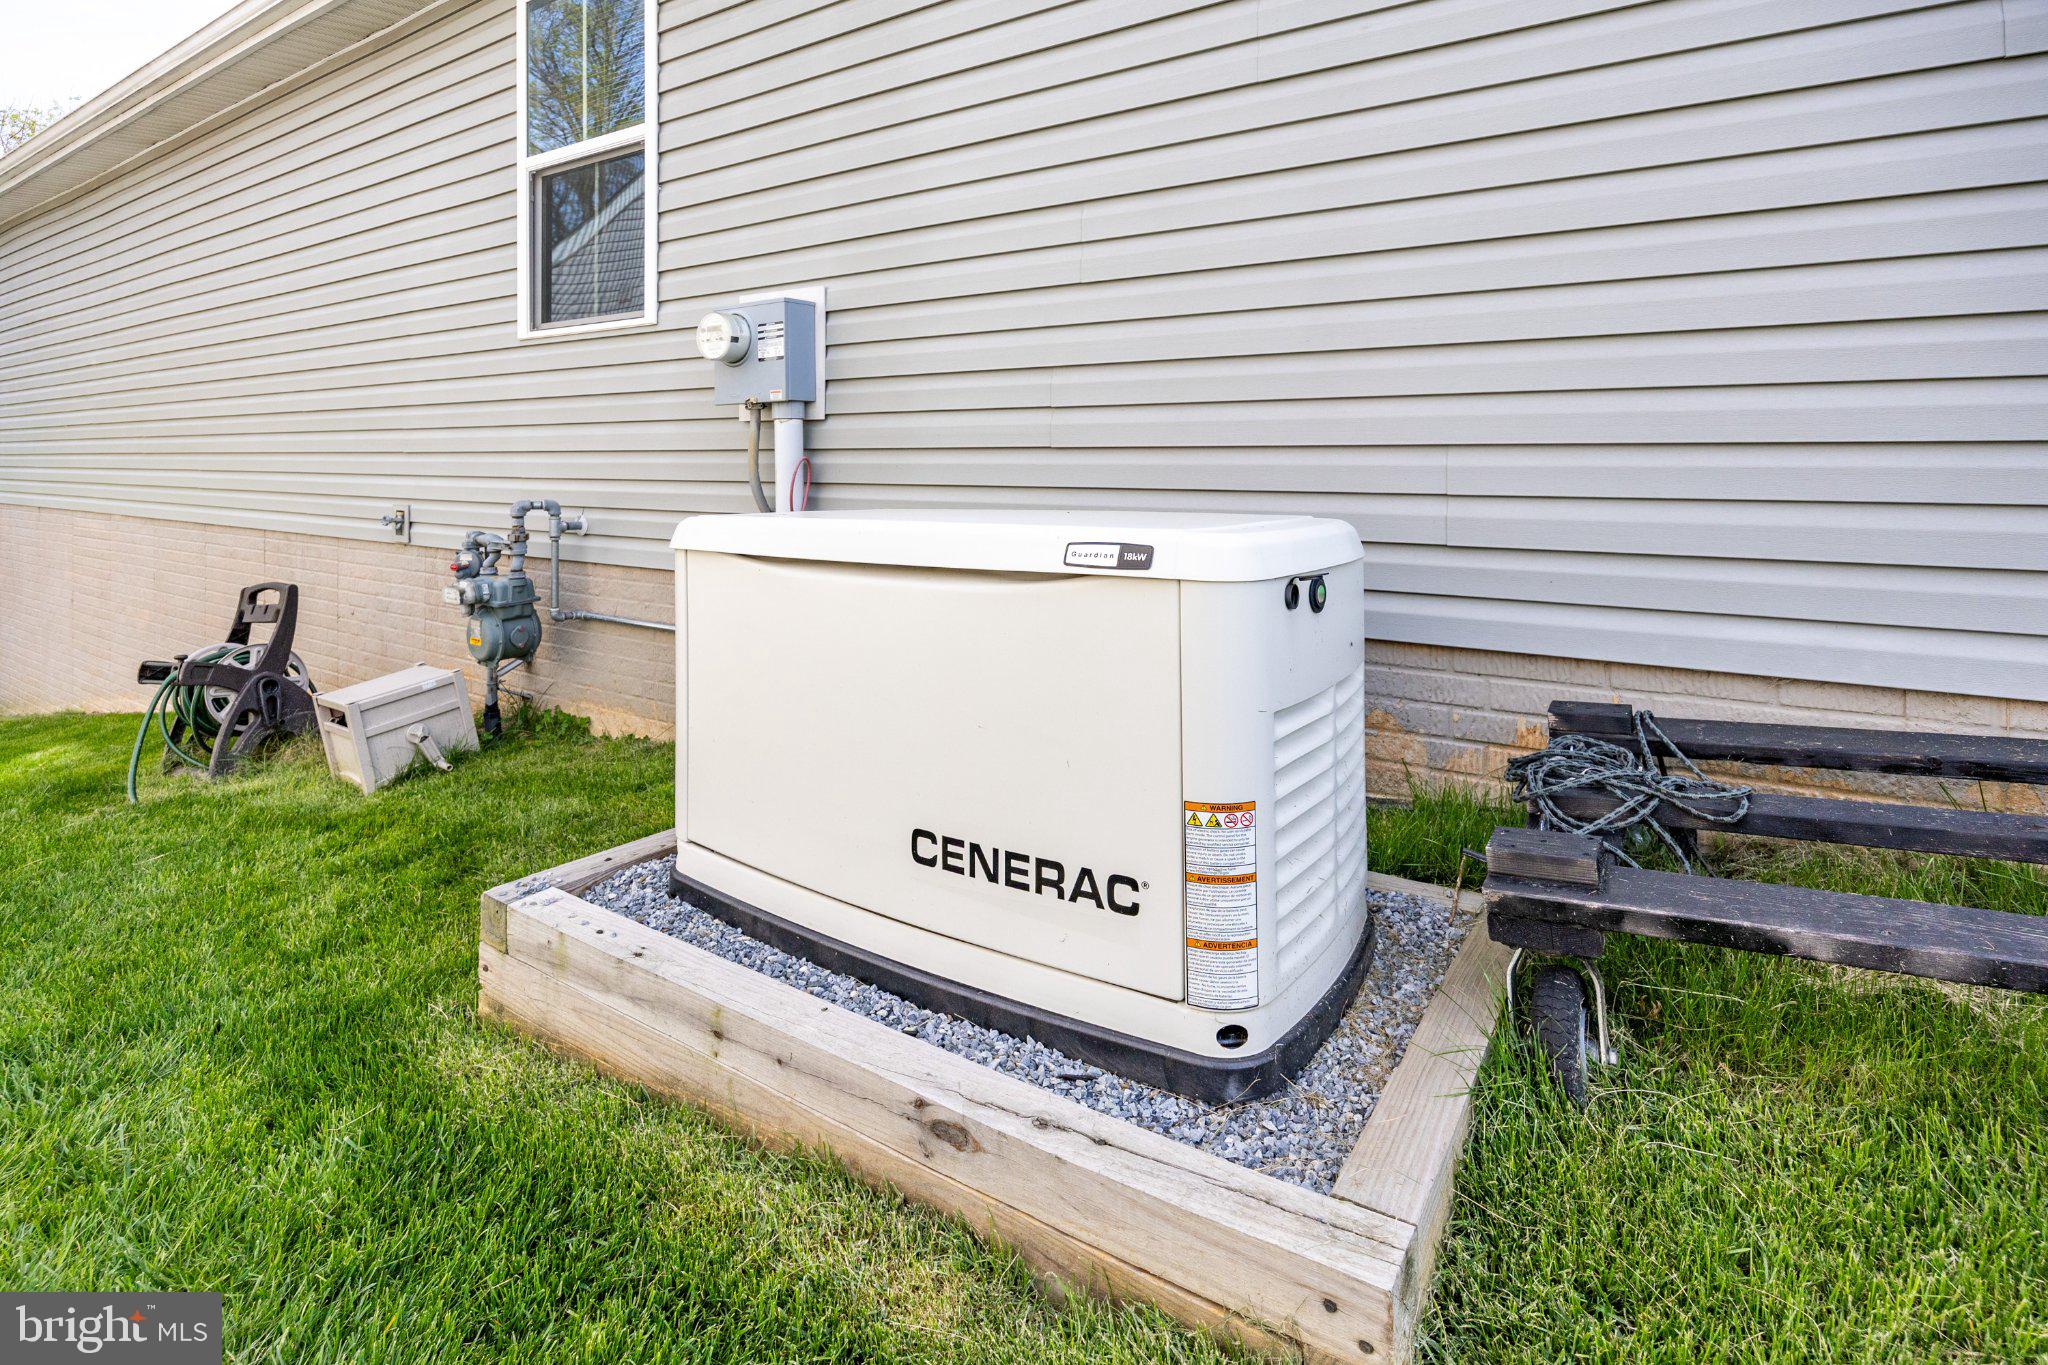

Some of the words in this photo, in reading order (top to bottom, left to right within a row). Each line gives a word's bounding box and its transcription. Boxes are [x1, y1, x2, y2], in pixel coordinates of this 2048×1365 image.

[1071, 551, 1114, 559] Guardian
[1123, 552, 1147, 561] 18kW
[1209, 804, 1243, 812] WARNING
[1197, 875, 1254, 884] AVERTISSEMENT
[1203, 941, 1252, 949] ADVERTENCIA
